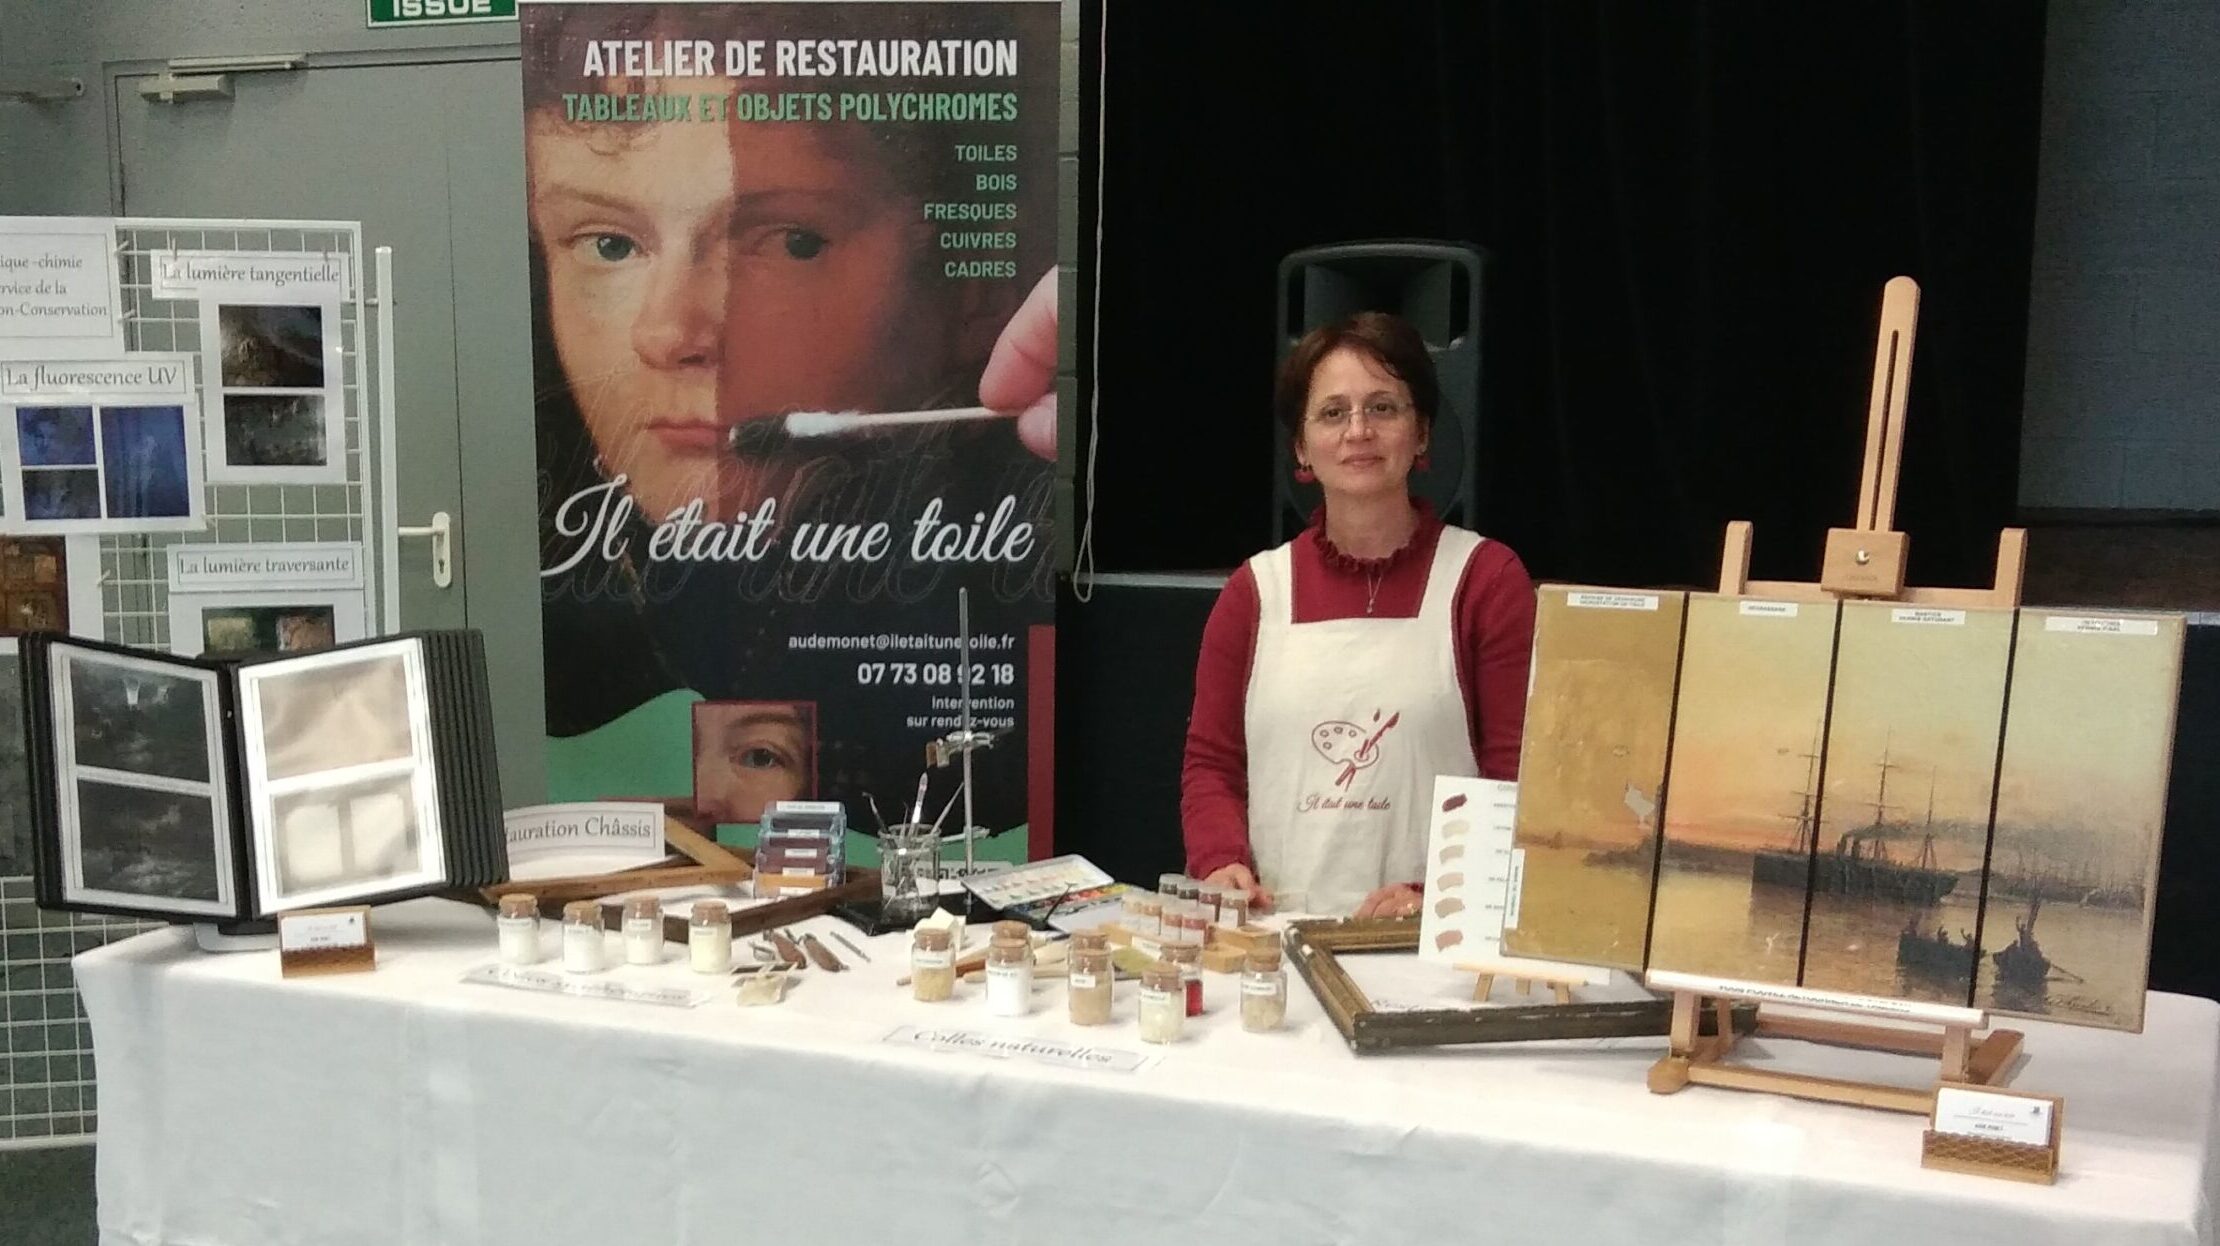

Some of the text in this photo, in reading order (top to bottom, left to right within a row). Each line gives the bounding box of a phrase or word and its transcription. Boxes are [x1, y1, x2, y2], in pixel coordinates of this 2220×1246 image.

[393, 0, 492, 18] ISSUE
[583, 39, 1018, 77] ATELIER DE RESTAURATION
[562, 92, 1018, 122] TABLEAUX ET OBJETS POLYCHROMES
[955, 145, 1018, 162] TOILES
[976, 174, 1018, 191] BOIS
[924, 203, 1018, 222] FRESQUES
[940, 232, 1017, 249] CUIVRES
[163, 261, 339, 287] La lumière tangentielle
[944, 261, 1017, 278] CADRES
[35, 279, 51, 294] de
[55, 279, 67, 294] la
[7, 364, 178, 391] La fluorescence UV
[540, 473, 1037, 577] Il était une toile
[180, 556, 349, 574] La lumière traversante
[788, 633, 1015, 650] audemonet@iletaituneoile.fr
[858, 663, 886, 685] 07
[890, 663, 917, 685] 73
[923, 663, 951, 685] 08
[991, 663, 1014, 685] 18
[932, 696, 1015, 710] Interention
[906, 715, 1015, 728] sur rendz-vous
[585, 815, 651, 838] Châssis
[914, 1030, 1113, 1064] Colles naturelles
